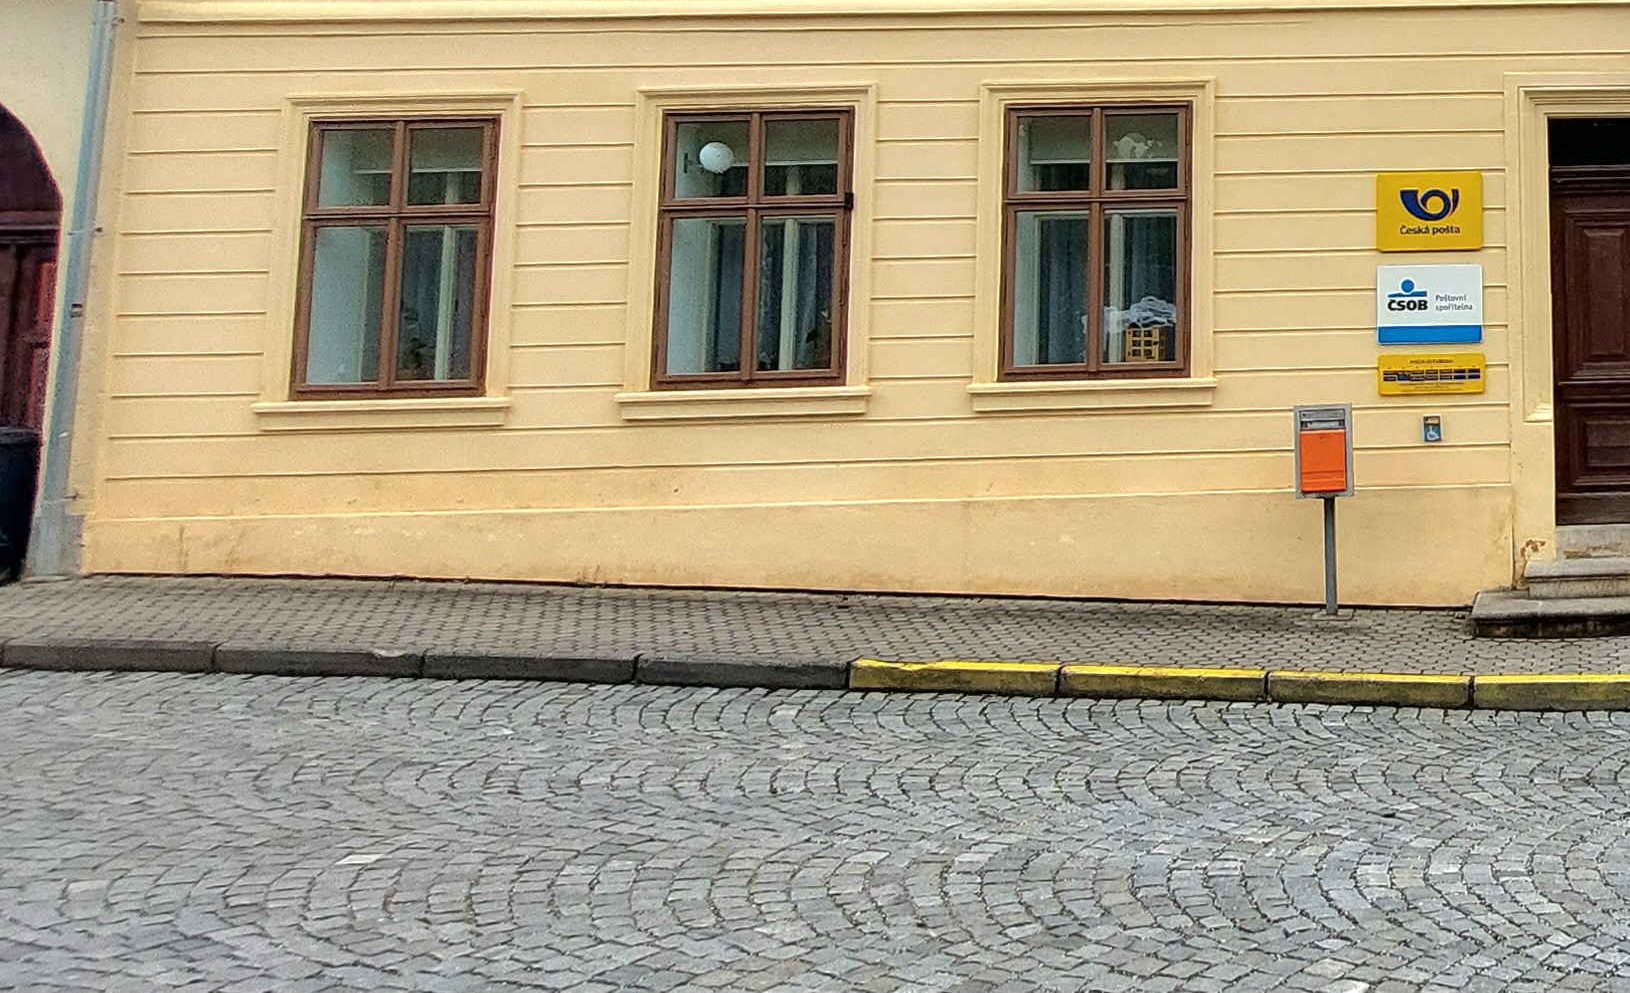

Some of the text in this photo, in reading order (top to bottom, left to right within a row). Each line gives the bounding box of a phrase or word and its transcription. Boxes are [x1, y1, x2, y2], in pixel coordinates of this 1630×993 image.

[1400, 224, 1460, 236] Česká pošta
[1435, 294, 1467, 302] Poštovní
[1387, 299, 1428, 311] ČSOB
[1435, 303, 1473, 312] spořitelna
